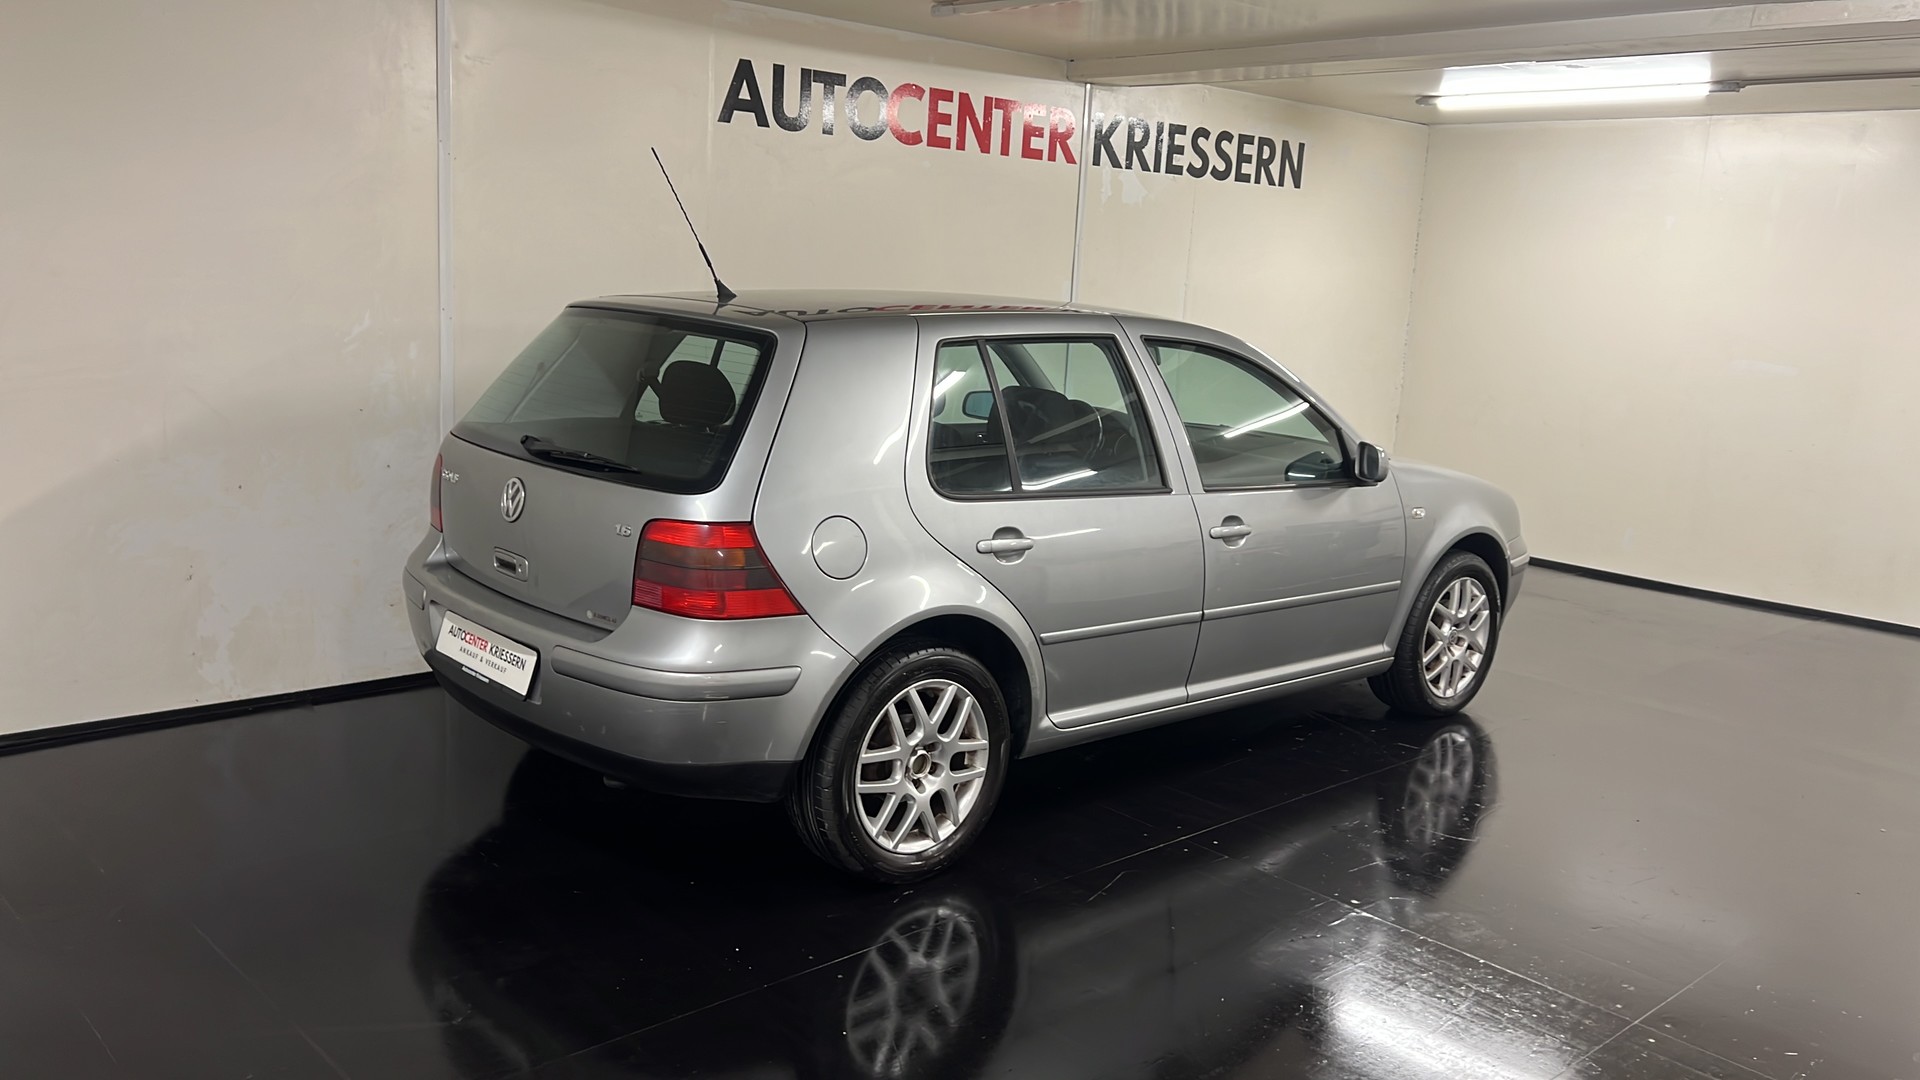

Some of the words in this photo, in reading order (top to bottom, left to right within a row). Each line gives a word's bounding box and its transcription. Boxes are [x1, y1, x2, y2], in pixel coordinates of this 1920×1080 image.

[717, 58, 1078, 166] AUTOCENTER
[1092, 111, 1306, 189] KRIESSERN
[448, 625, 489, 652] AUTOCENTER
[489, 643, 527, 671] KRIESSERN
[479, 655, 484, 663] &
[485, 658, 508, 674] VERKAUF
